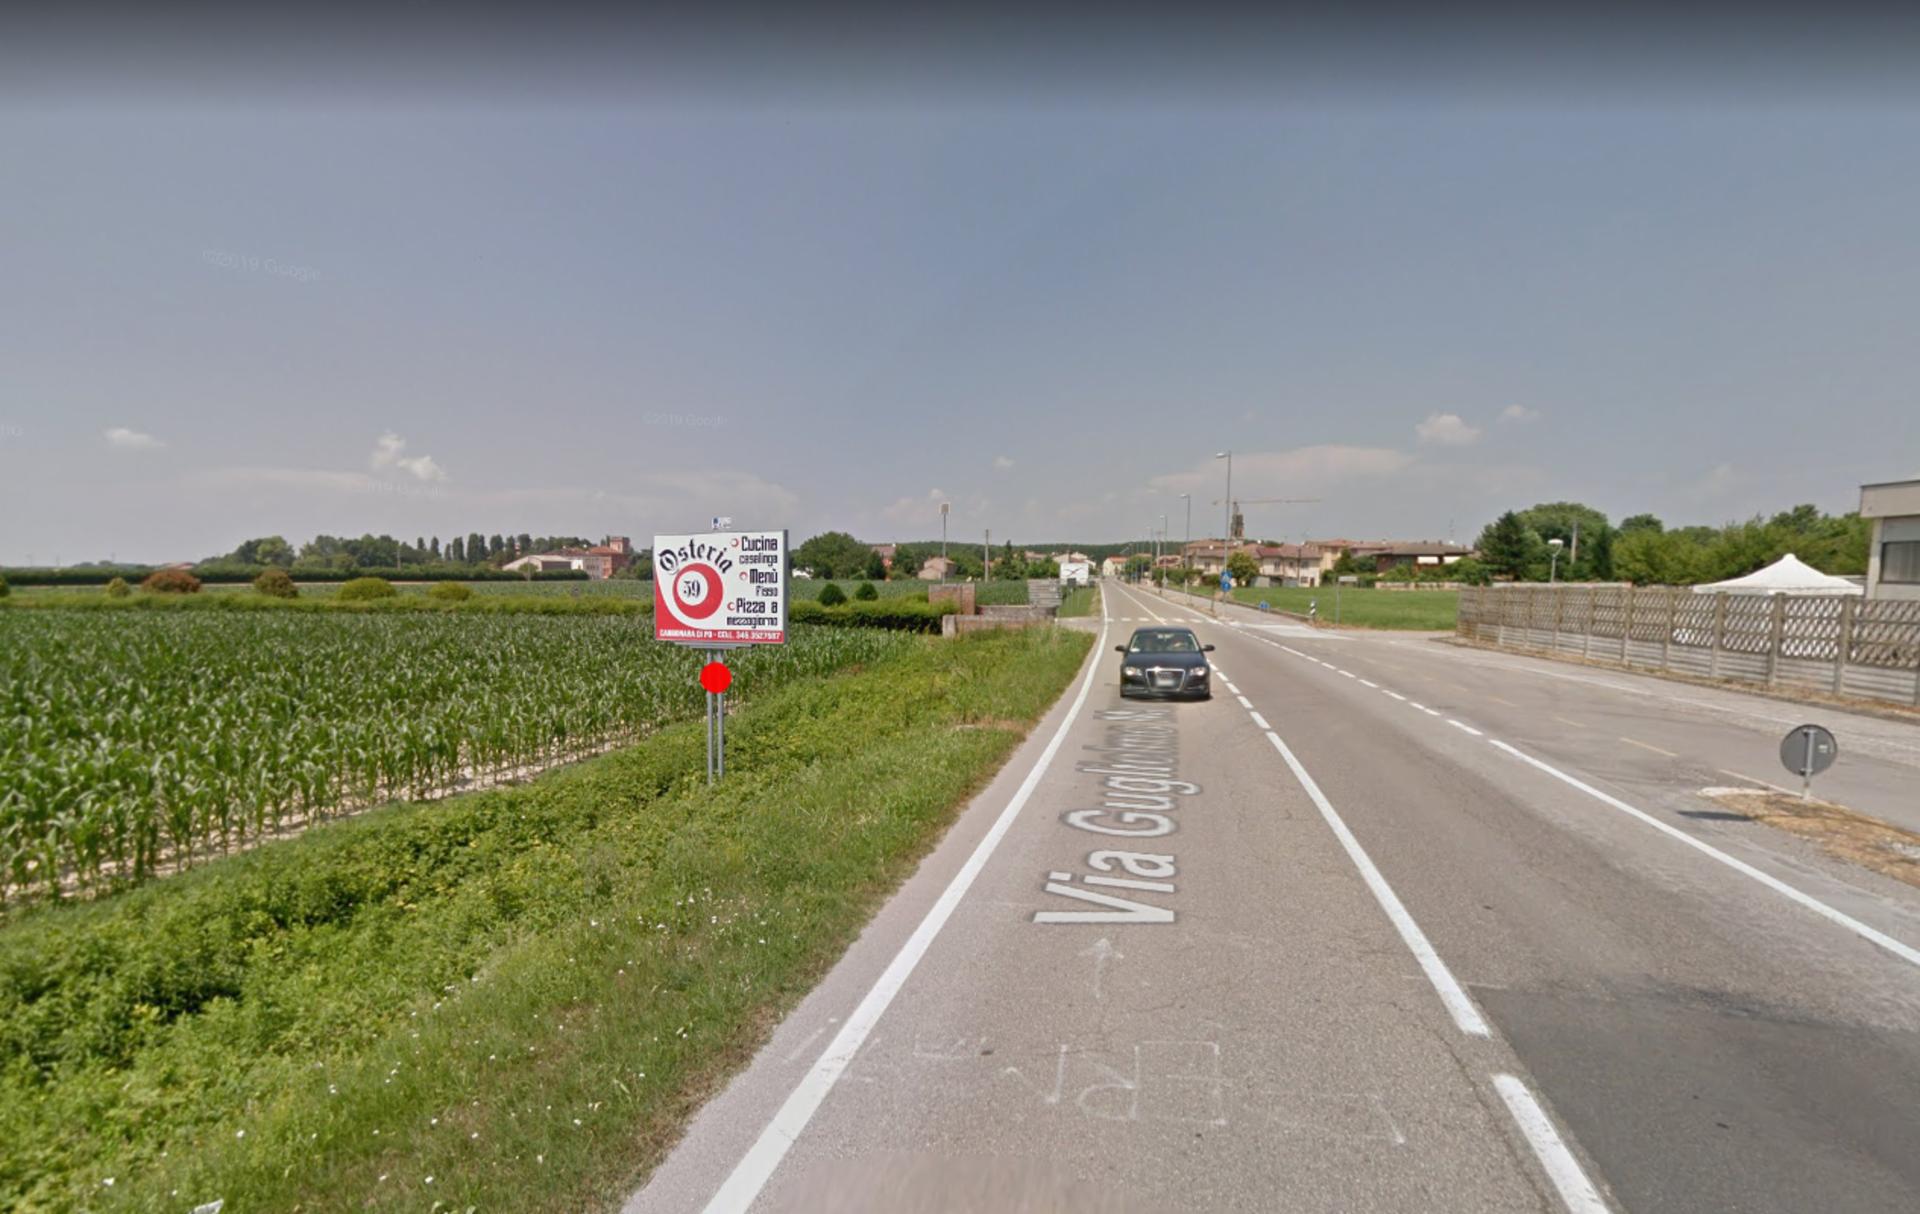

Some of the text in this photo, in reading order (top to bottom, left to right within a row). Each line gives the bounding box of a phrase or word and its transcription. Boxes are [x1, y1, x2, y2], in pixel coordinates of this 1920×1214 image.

[741, 535, 778, 551] Cucina
[658, 538, 733, 575] Osteria
[749, 568, 778, 584] Menù
[683, 579, 701, 598] 59
[736, 598, 778, 614] Pizza a
[726, 615, 778, 629] mezzogiorno
